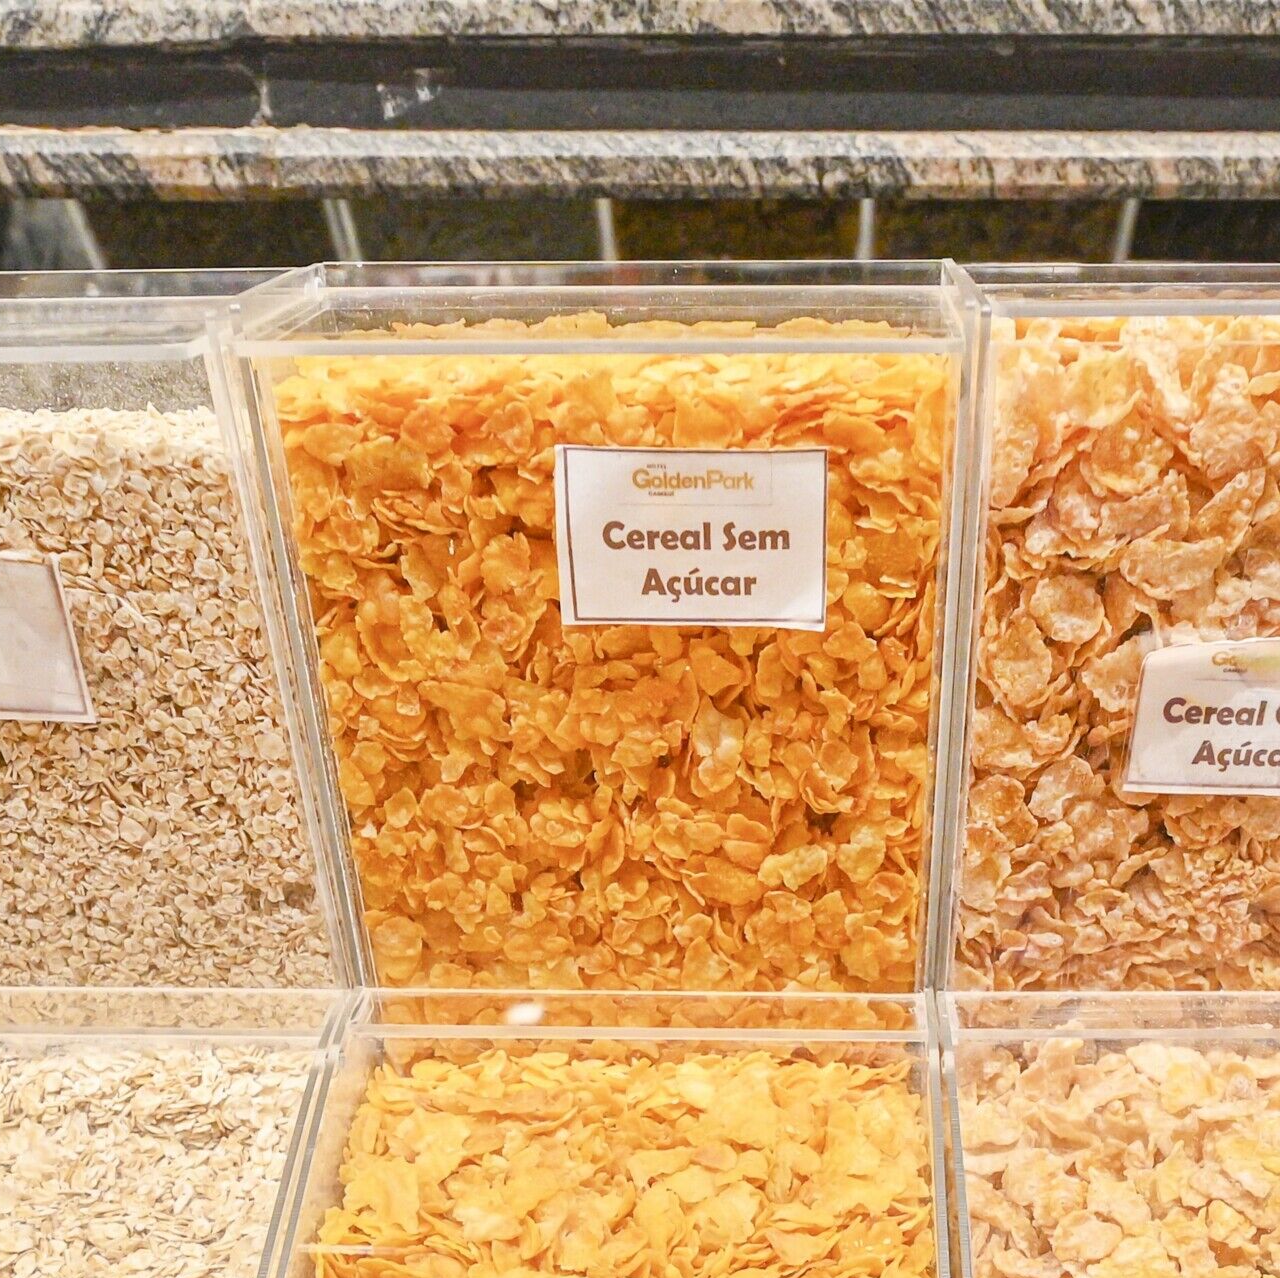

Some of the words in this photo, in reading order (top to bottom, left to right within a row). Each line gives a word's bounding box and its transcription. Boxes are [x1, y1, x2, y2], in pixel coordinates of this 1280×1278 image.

[631, 468, 754, 490] GoldenPark
[602, 520, 712, 551] Cereal
[722, 521, 791, 551] Sem
[641, 567, 758, 603] Açúcar
[1162, 696, 1268, 727] Cereal
